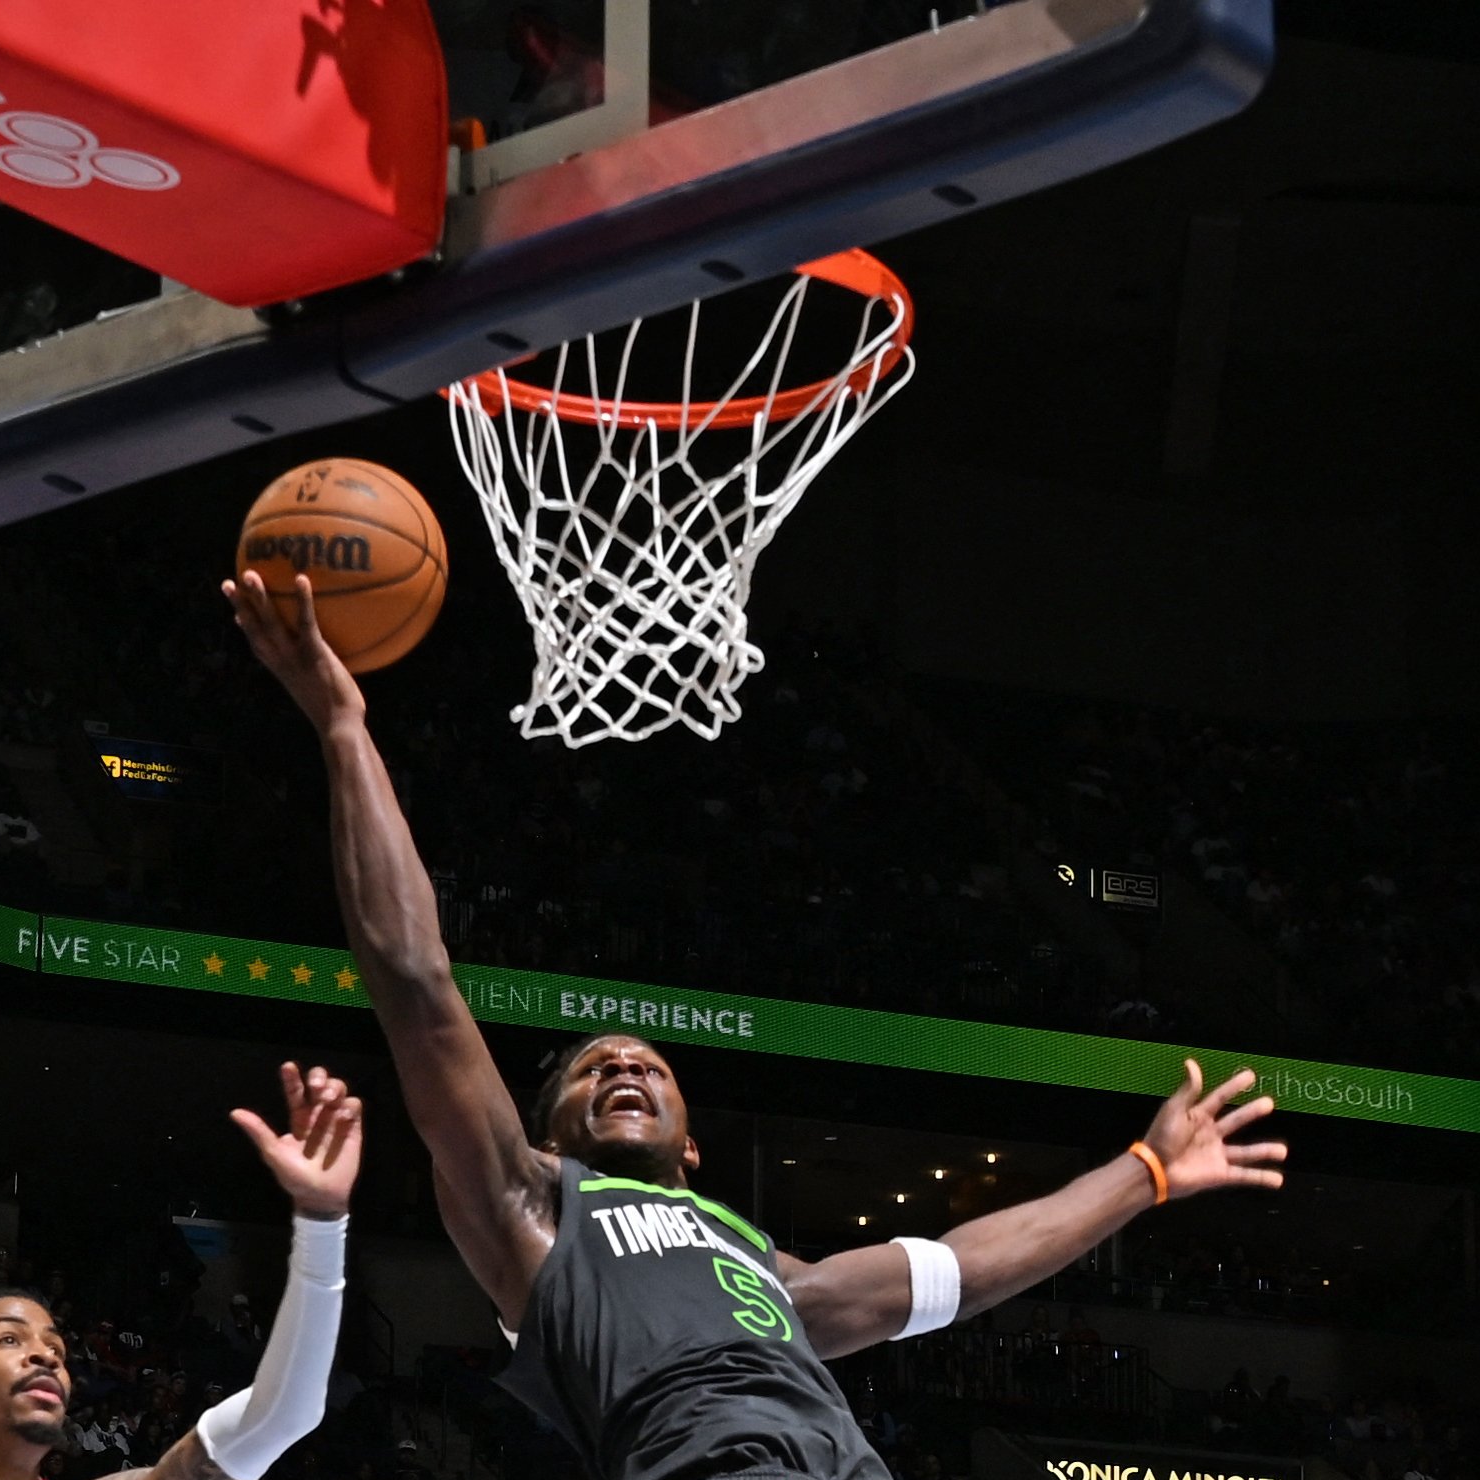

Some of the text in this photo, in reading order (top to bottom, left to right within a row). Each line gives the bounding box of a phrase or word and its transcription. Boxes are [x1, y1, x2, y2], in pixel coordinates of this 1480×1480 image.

[1107, 876, 1155, 896] BRS
[18, 928, 181, 973] FIVE STAR
[465, 980, 755, 1038] TIENT EXPERIENCE
[712, 1256, 793, 1343] 5
